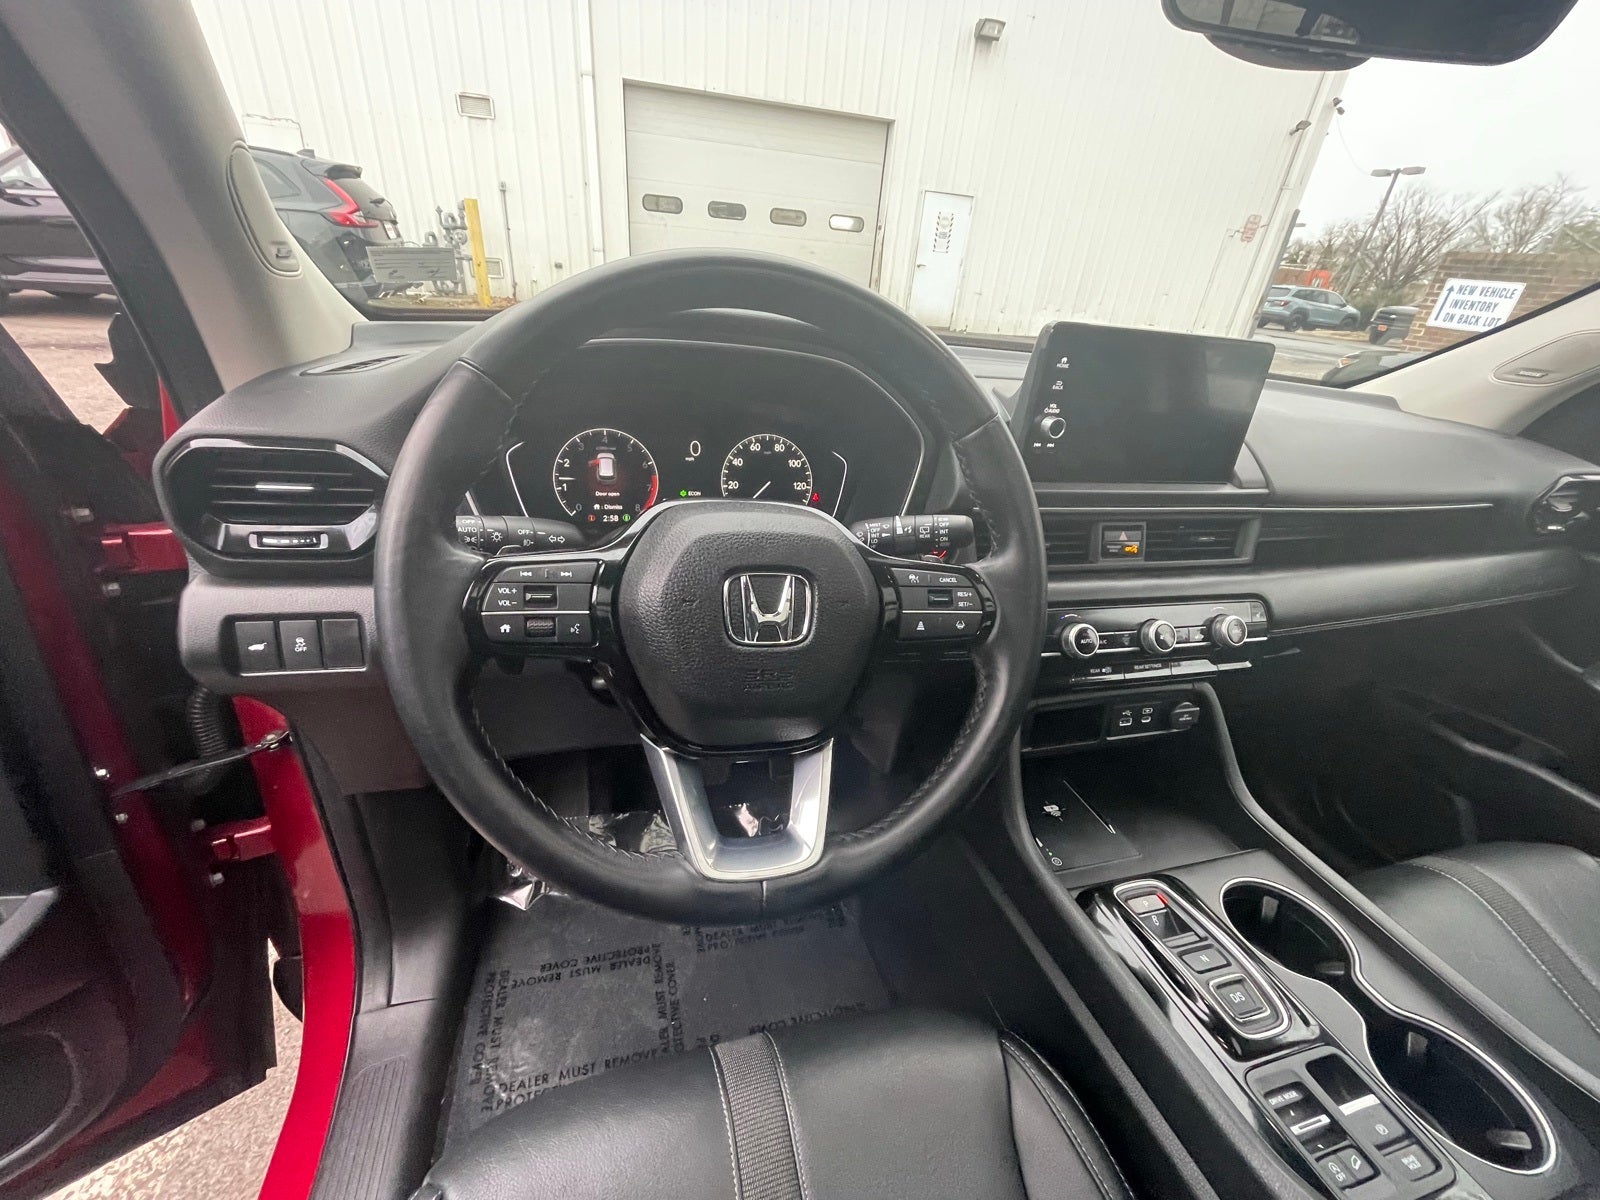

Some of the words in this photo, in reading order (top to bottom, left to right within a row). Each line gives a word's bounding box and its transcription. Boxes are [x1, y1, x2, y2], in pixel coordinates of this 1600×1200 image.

[1456, 284, 1477, 295] NEW
[1479, 286, 1517, 299] VEHICLE
[1449, 299, 1500, 312] INVENTORY
[1443, 312, 1456, 323] ON
[1457, 315, 1482, 326] BACK
[1483, 318, 1501, 327] LOT
[602, 436, 608, 444] 4
[578, 443, 585, 451] 3
[627, 444, 633, 452] 5
[690, 440, 701, 456] 0
[750, 443, 761, 452] 60
[774, 444, 785, 452] 80
[563, 459, 570, 467] 2
[732, 458, 743, 466] 40
[788, 460, 802, 468] 100
[562, 483, 567, 492] 1
[728, 481, 739, 490] 20
[793, 482, 807, 490] 120
[575, 503, 582, 512] 0
[635, 504, 641, 512] 8
[584, 944, 651, 965] PROTECTIVE
[540, 958, 578, 973] COVER
[610, 956, 651, 971] DEALER
[652, 943, 664, 984] REMOVE
[570, 964, 602, 978] MUST
[511, 972, 562, 989] REMOVE
[666, 961, 678, 996] COVER
[496, 970, 510, 1009] DEALER
[1229, 991, 1245, 1004] D/S
[656, 990, 668, 1019] MUST
[490, 1016, 503, 1050] MUST
[498, 1072, 549, 1094] DEALER
[558, 1062, 596, 1081] MUST
[604, 1048, 658, 1069] REMOVE
[1268, 1095, 1285, 1105] DRIVE
[1283, 1090, 1299, 1099] MODE
